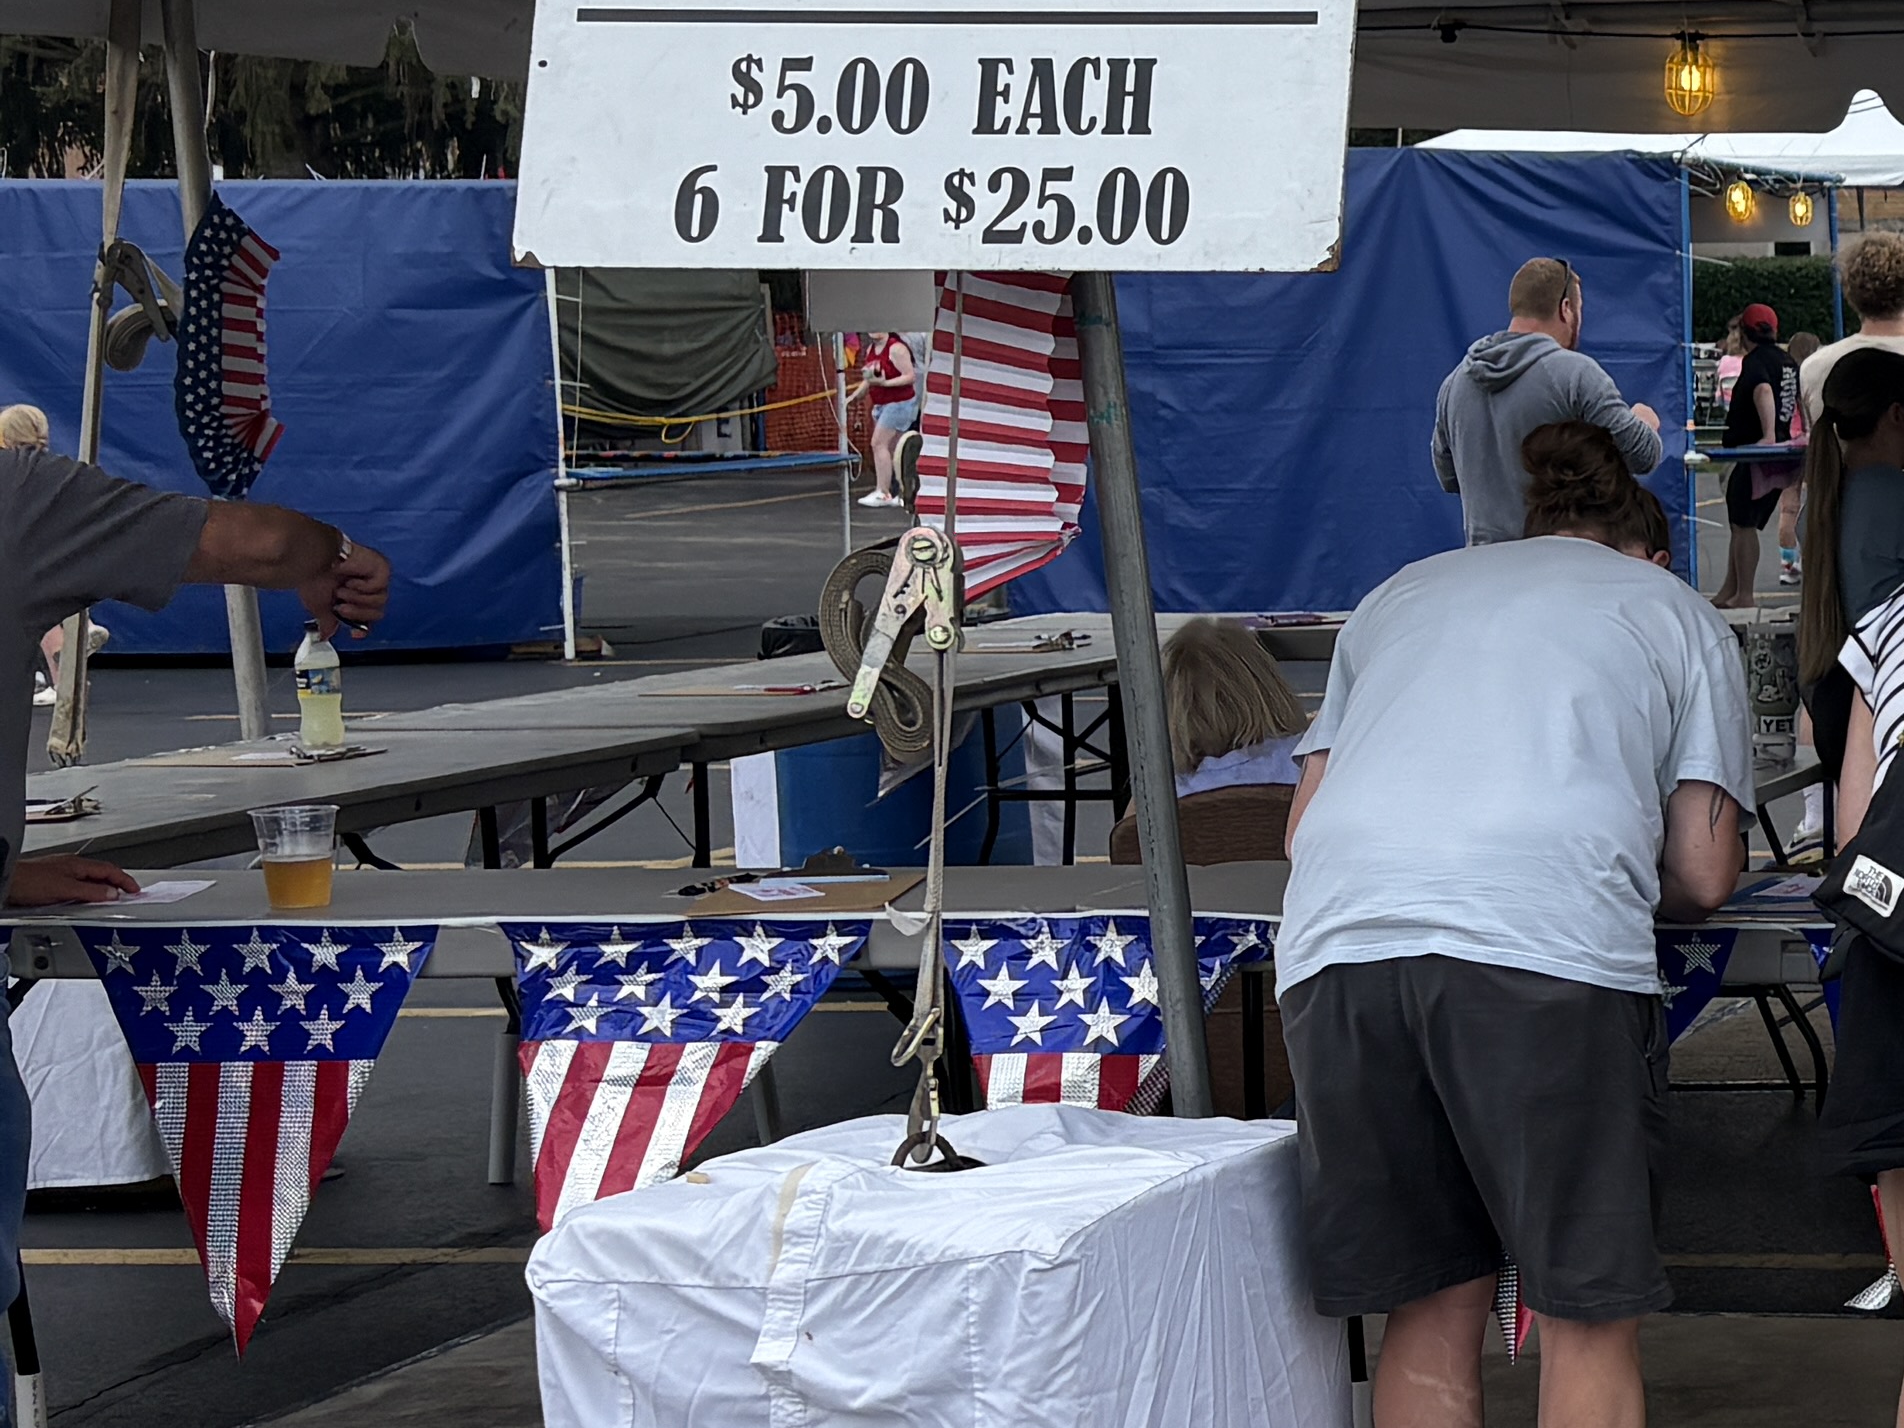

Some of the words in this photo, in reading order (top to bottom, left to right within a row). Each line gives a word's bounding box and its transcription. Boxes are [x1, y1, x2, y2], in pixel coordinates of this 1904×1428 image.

[729, 54, 930, 135] $5.00
[972, 57, 1158, 135] EACH
[674, 164, 719, 244] 6
[757, 165, 905, 245] FOR
[943, 165, 1190, 245] $25.00
